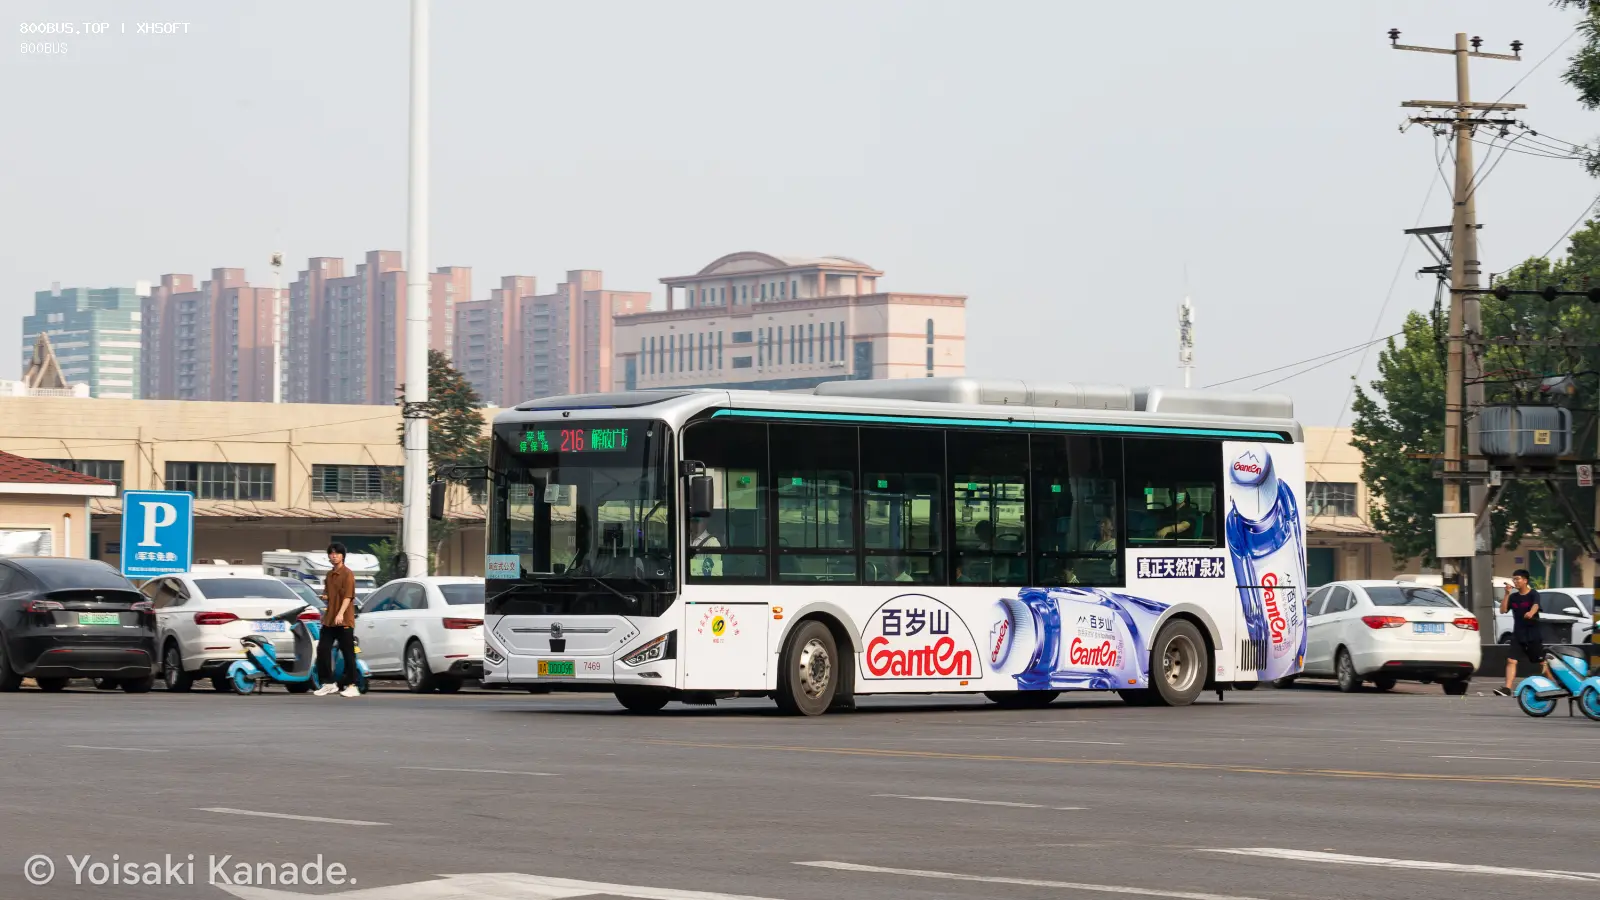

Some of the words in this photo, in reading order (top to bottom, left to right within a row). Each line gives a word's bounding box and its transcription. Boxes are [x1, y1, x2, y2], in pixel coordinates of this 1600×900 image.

[560, 429, 584, 452] 216
[137, 501, 178, 547] P
[1138, 558, 1224, 577] 真正天然矿泉水
[882, 608, 949, 636] 百岁山
[1090, 614, 1114, 632] 百岁山
[583, 661, 601, 671] 7469
